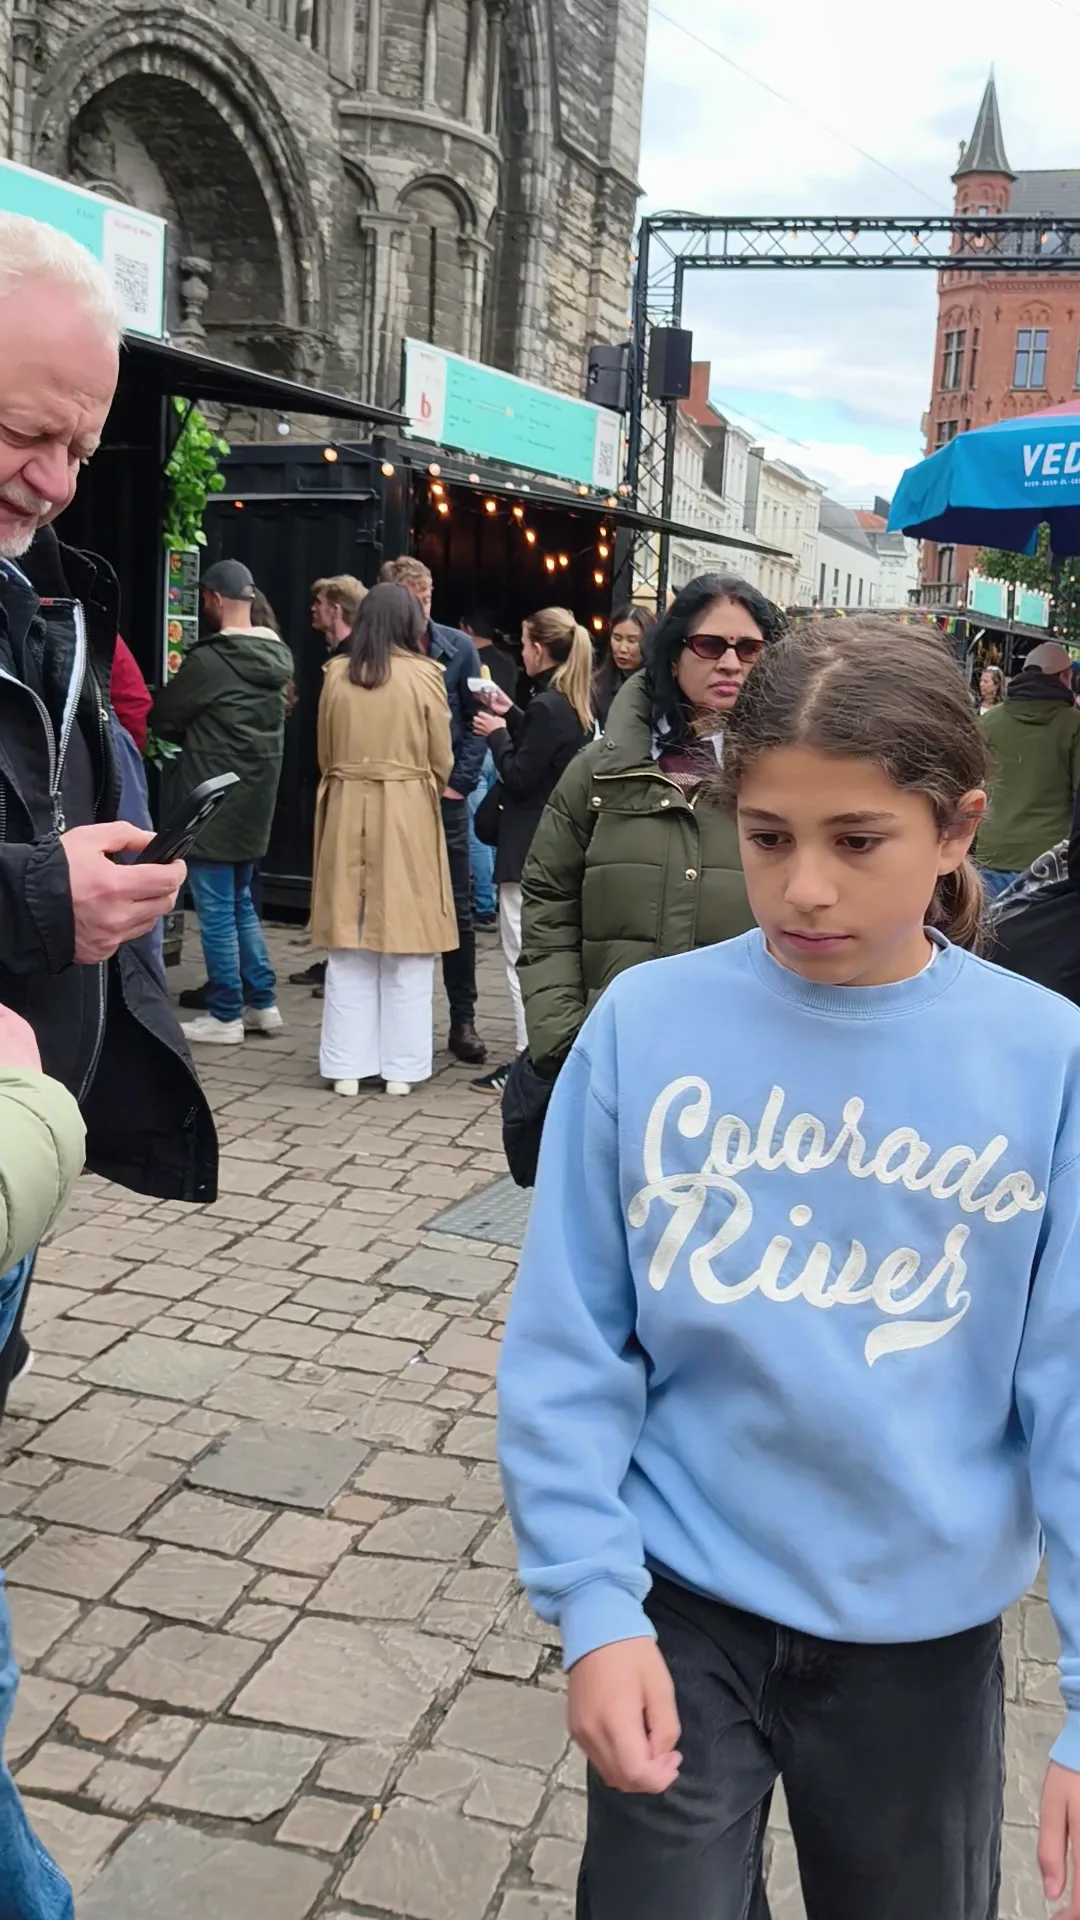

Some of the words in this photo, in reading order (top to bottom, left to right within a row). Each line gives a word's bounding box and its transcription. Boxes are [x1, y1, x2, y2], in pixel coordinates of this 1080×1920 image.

[1023, 442, 1080, 476] VED
[643, 1075, 1046, 1223] Colorado
[628, 1171, 971, 1367] River
